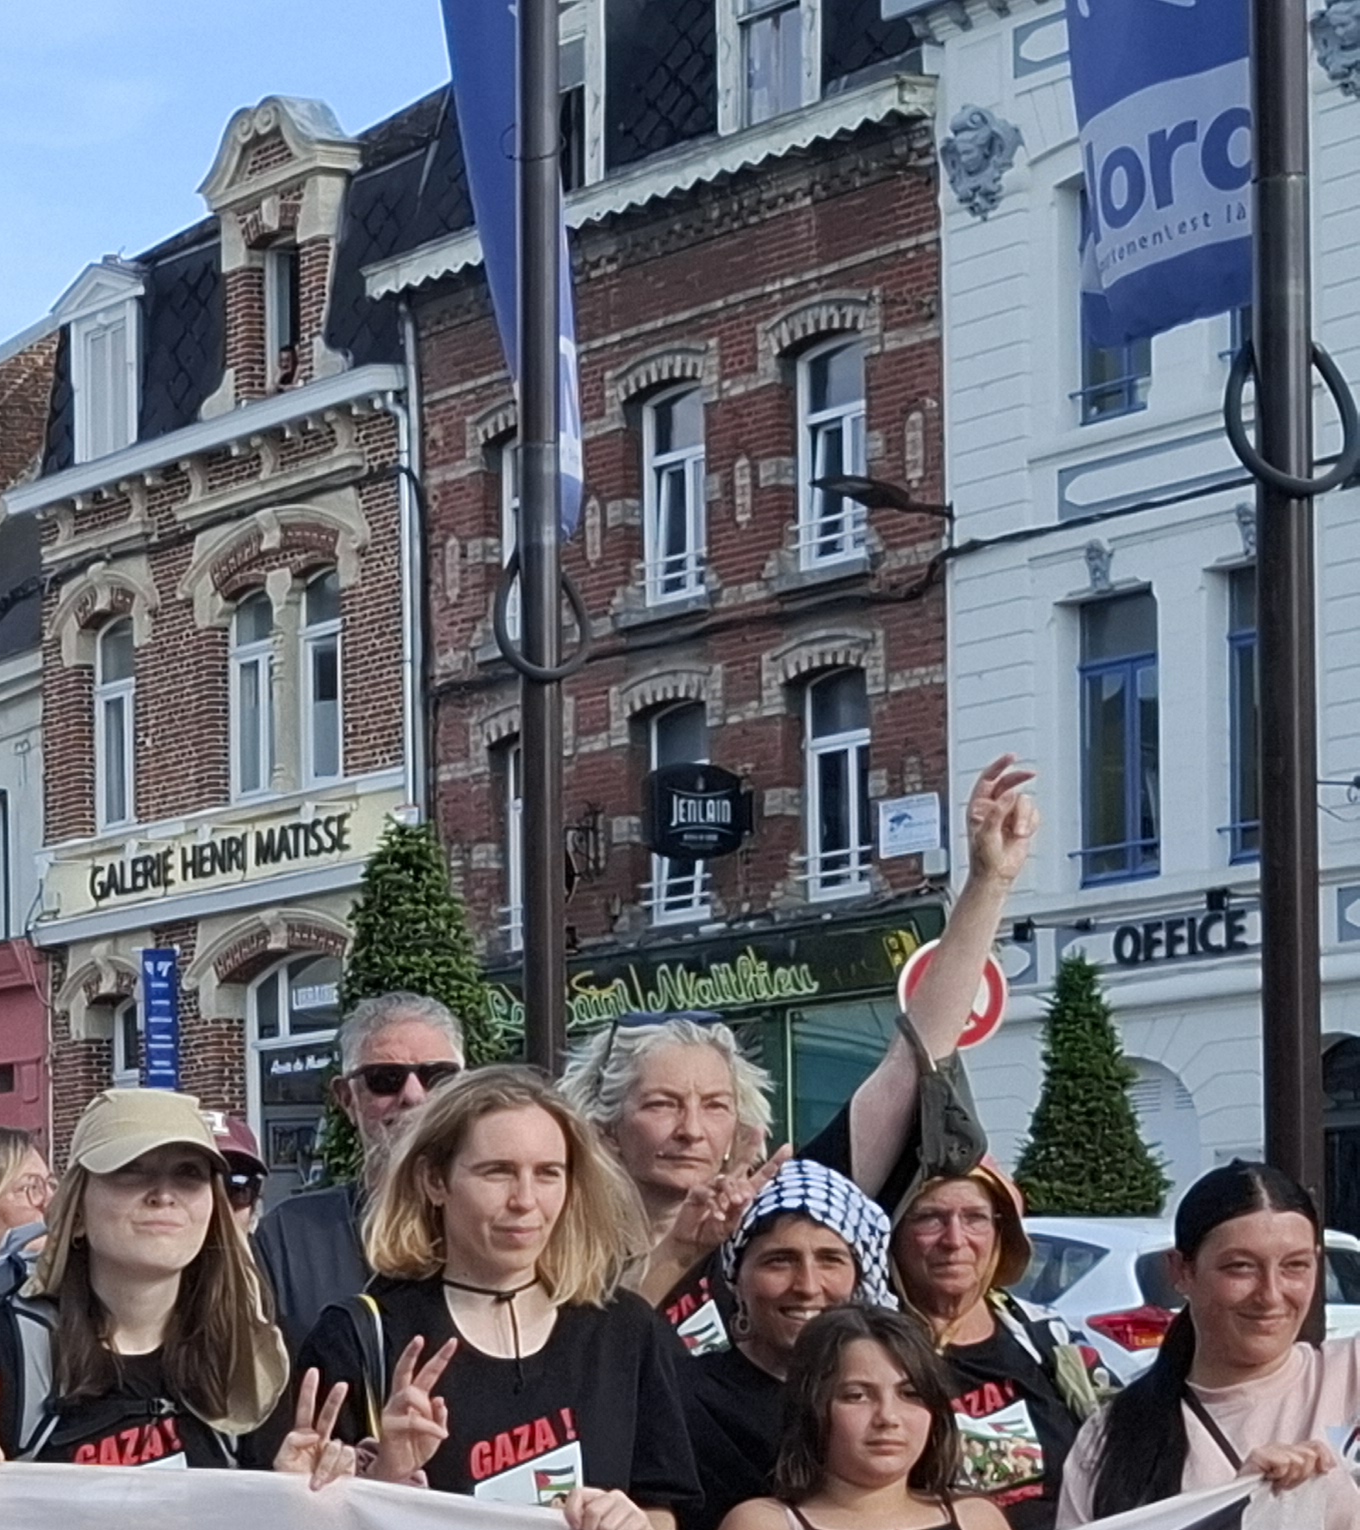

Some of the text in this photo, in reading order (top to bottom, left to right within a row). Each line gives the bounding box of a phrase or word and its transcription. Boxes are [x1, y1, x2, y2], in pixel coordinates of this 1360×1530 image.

[670, 794, 731, 827] JENLAIN
[89, 812, 352, 901] GALERIE HENRI MATISSE
[1113, 909, 1249, 966] OFFICE
[75, 1424, 164, 1466] GAZA
[470, 1417, 558, 1480] GAZA
